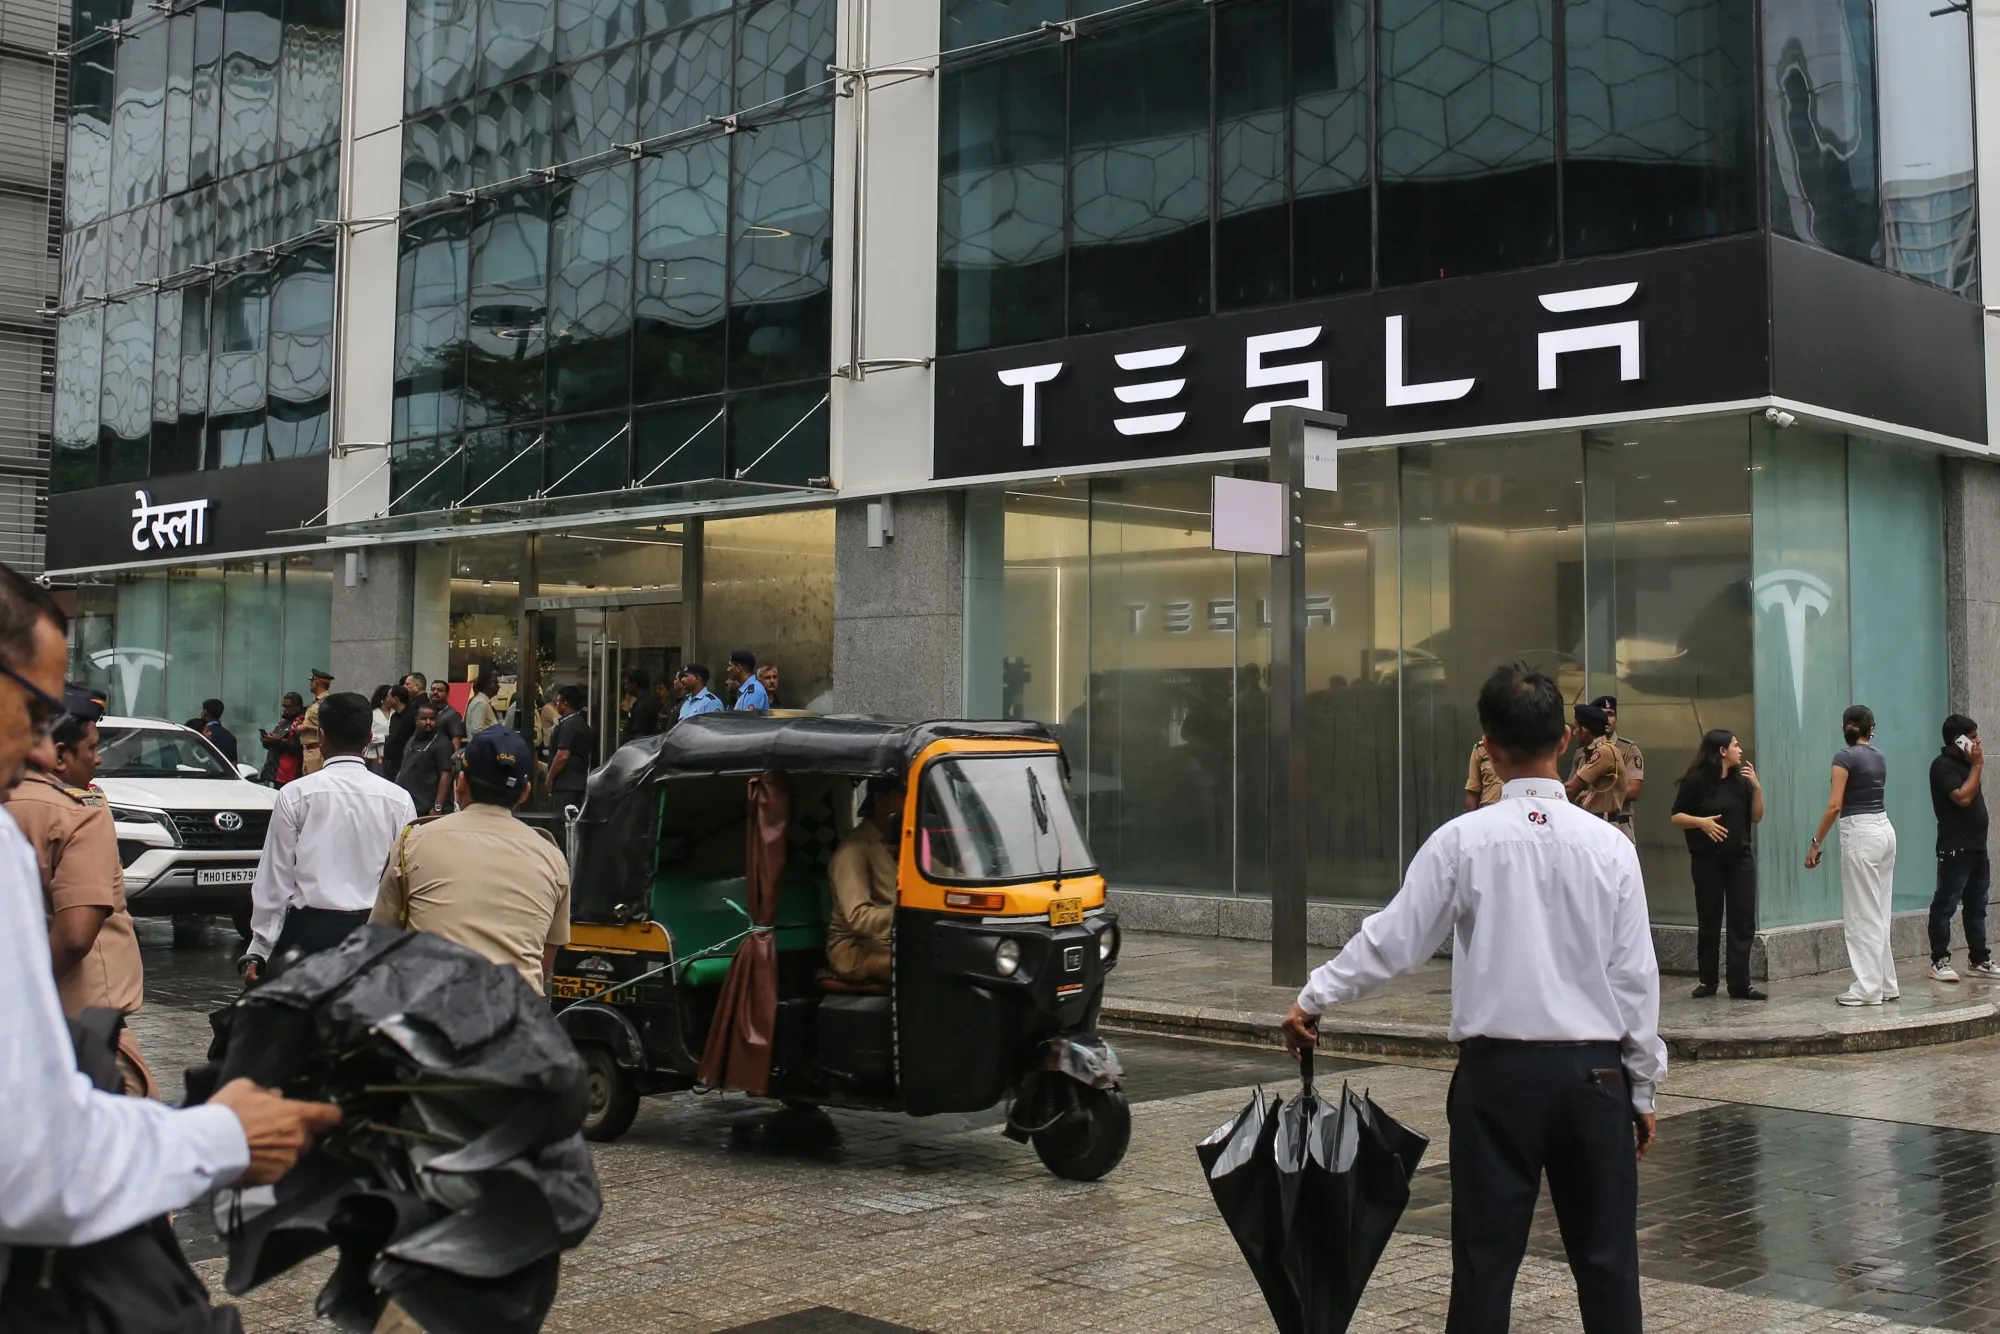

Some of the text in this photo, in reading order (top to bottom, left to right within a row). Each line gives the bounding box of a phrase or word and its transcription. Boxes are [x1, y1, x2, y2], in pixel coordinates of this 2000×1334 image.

[997, 282, 1641, 446] TESLA
[132, 490, 208, 551] टेस्ला
[1122, 596, 1333, 634] TESLA
[448, 637, 501, 649] TESLA
